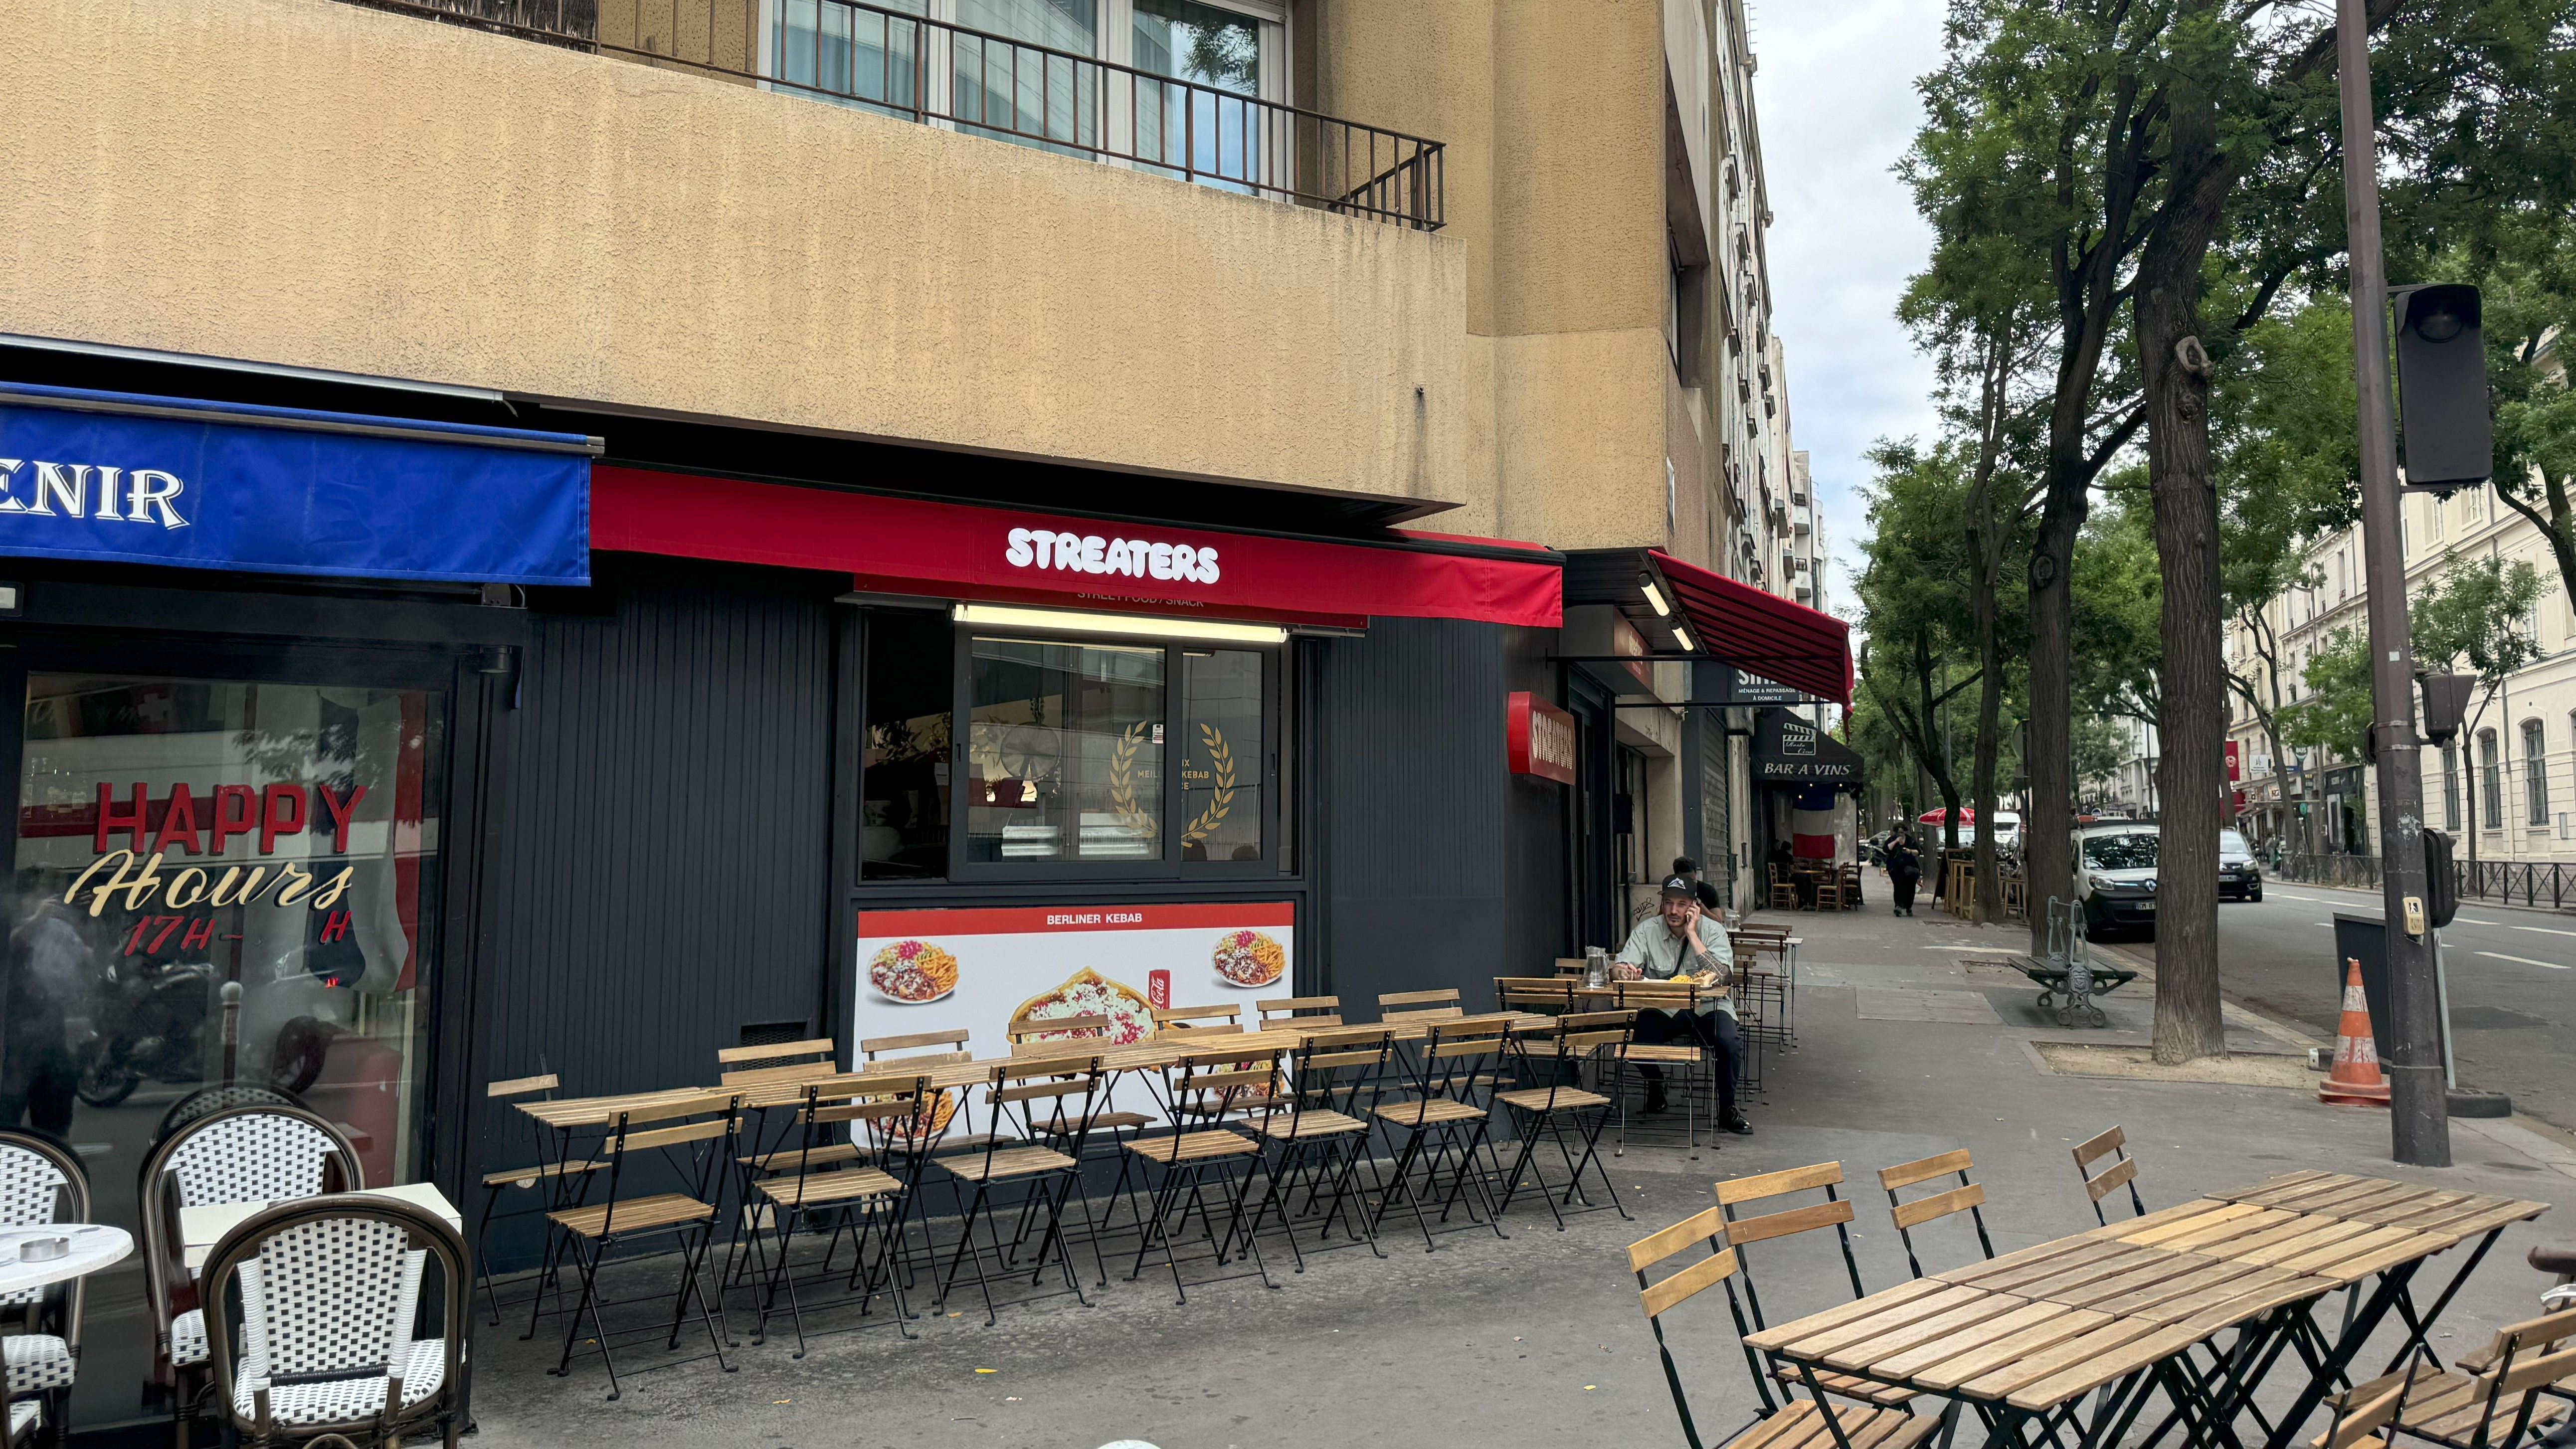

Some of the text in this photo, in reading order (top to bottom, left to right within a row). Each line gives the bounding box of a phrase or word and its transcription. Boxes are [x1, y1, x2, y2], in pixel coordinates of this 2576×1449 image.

[1005, 528, 1220, 584] STREATERS
[1532, 710, 1572, 769] STREATERS
[1765, 763, 1851, 775] BAR A VINS
[94, 782, 366, 853] HAPPY
[64, 850, 354, 916] Hours
[1047, 913, 1142, 925] BERLINER KEBAB
